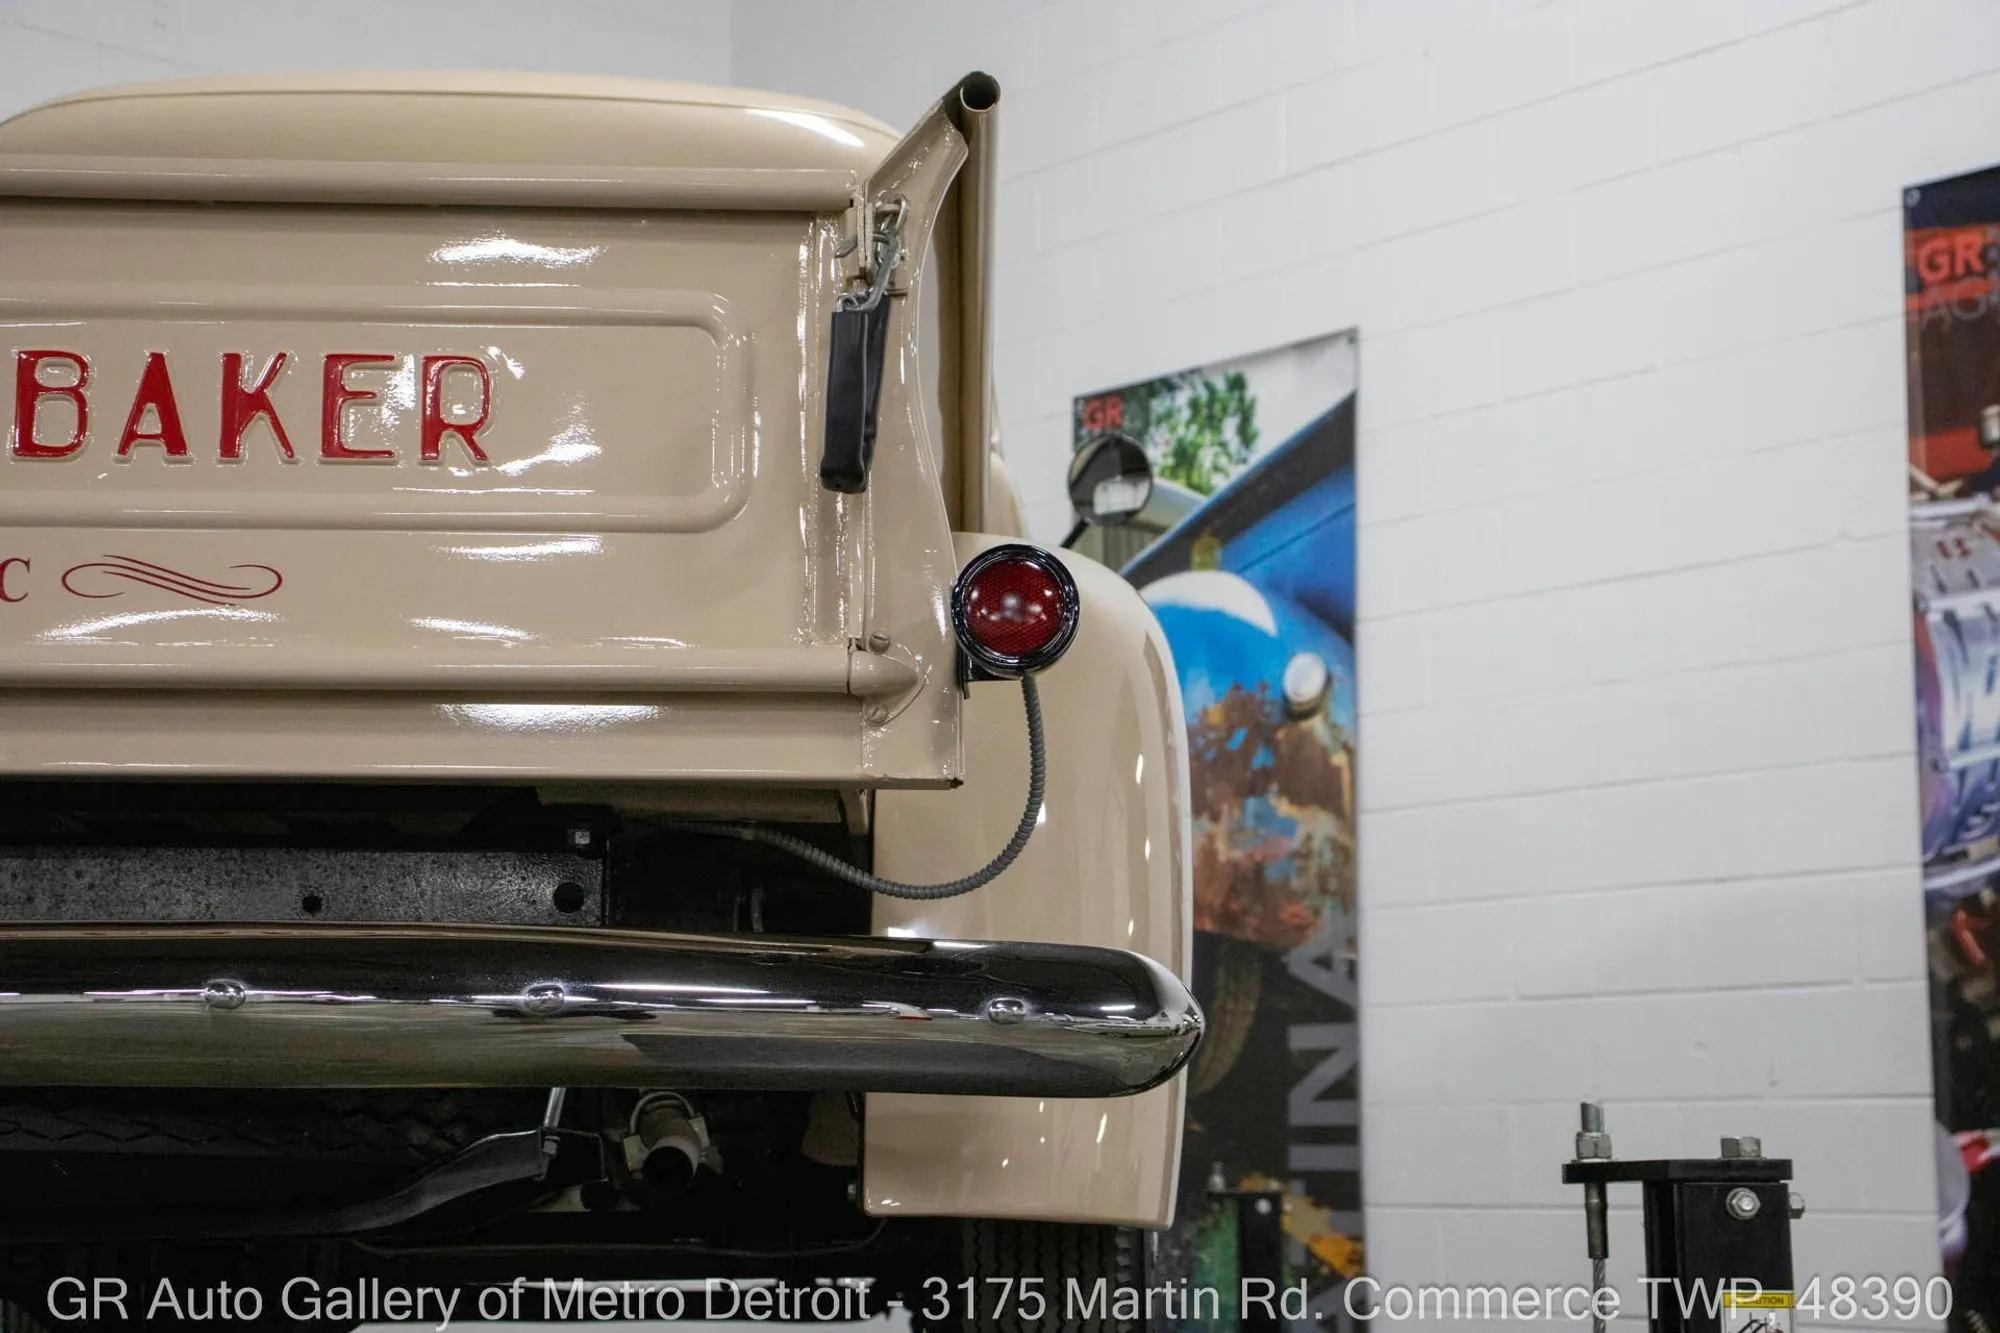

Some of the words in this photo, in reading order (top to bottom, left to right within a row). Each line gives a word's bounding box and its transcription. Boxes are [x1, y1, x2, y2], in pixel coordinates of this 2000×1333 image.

[1918, 232, 1984, 283] GR
[12, 350, 489, 462] BAKER
[1084, 394, 1123, 431] GR
